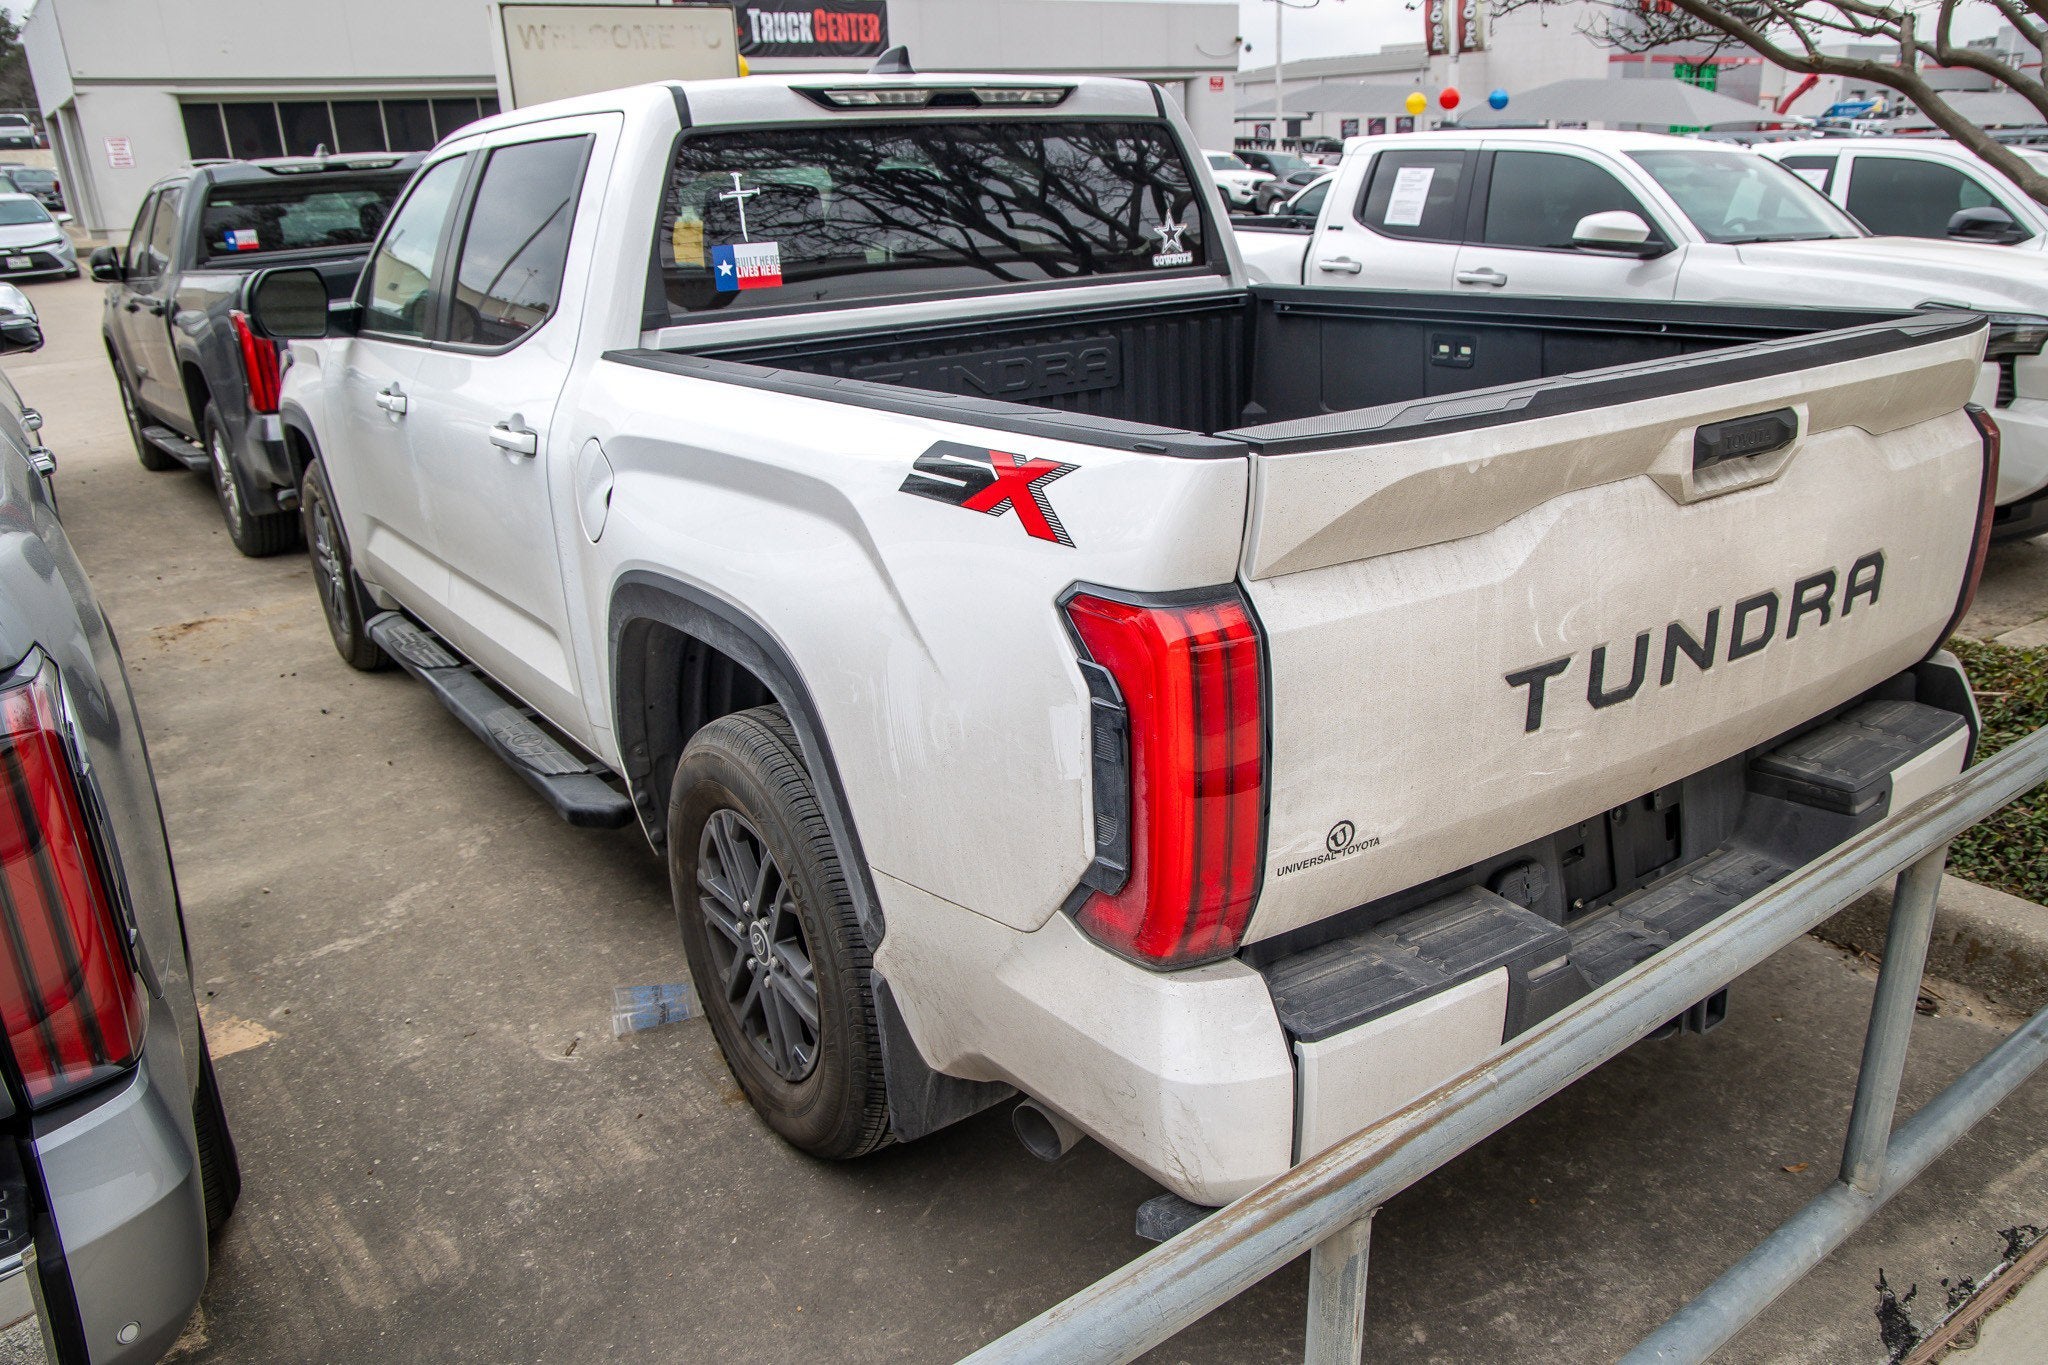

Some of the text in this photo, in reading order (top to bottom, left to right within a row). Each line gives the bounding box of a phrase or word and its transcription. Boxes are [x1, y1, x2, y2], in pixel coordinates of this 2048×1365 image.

[747, 8, 881, 44] TRUCK CENTER
[736, 255, 779, 267] BUILT HERE
[736, 264, 782, 278] LIVES HERE
[1153, 251, 1193, 267] COWBOYS
[1505, 549, 1884, 734] TUNDRA
[1277, 837, 1380, 877] UNIVERSAL TOYOTA
